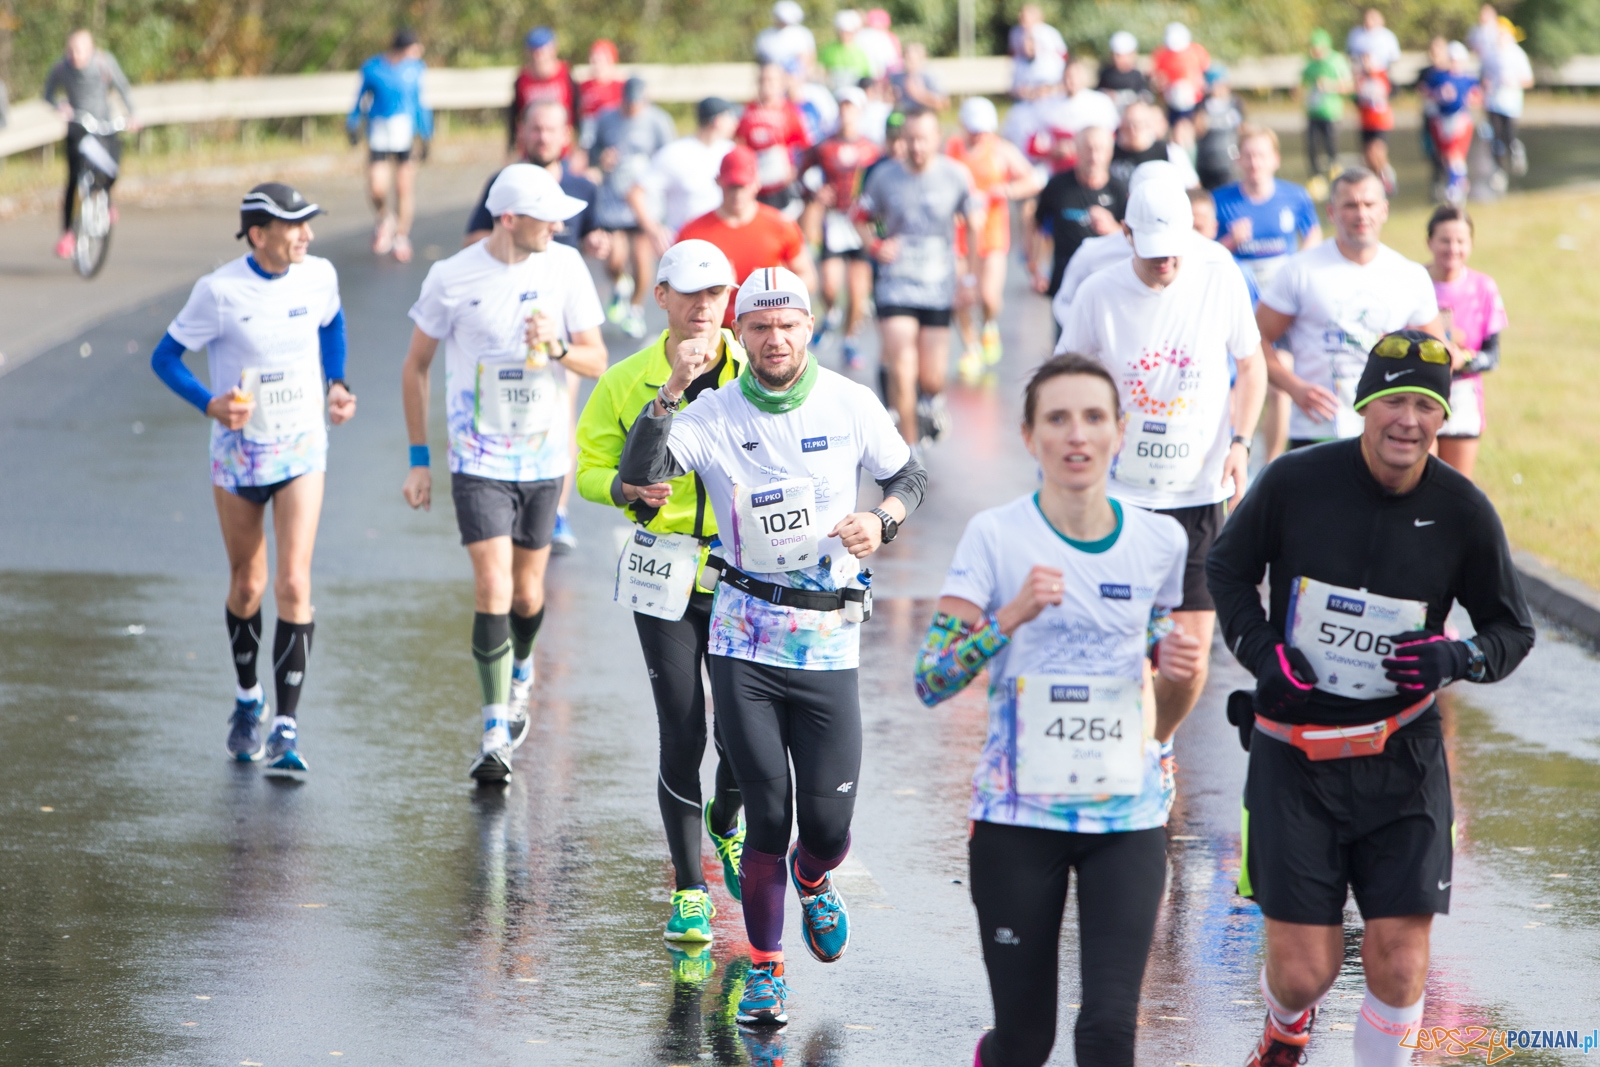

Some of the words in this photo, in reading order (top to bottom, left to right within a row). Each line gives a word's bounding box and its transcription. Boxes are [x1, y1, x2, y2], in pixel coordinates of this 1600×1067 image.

[260, 387, 303, 406] 3104
[500, 387, 541, 404] 3156
[741, 442, 759, 451] 4F
[803, 440, 827, 449] 17.PKO
[1137, 441, 1190, 459] 6000
[754, 492, 782, 504] 17.PKO
[760, 508, 810, 534] 1021
[771, 534, 807, 547] Damian
[798, 553, 808, 561] 4F
[628, 553, 672, 580] 5144
[629, 576, 662, 591] Sławomir
[1318, 622, 1392, 656] 5706
[1044, 717, 1123, 742] 4264
[836, 781, 853, 793] 4F
